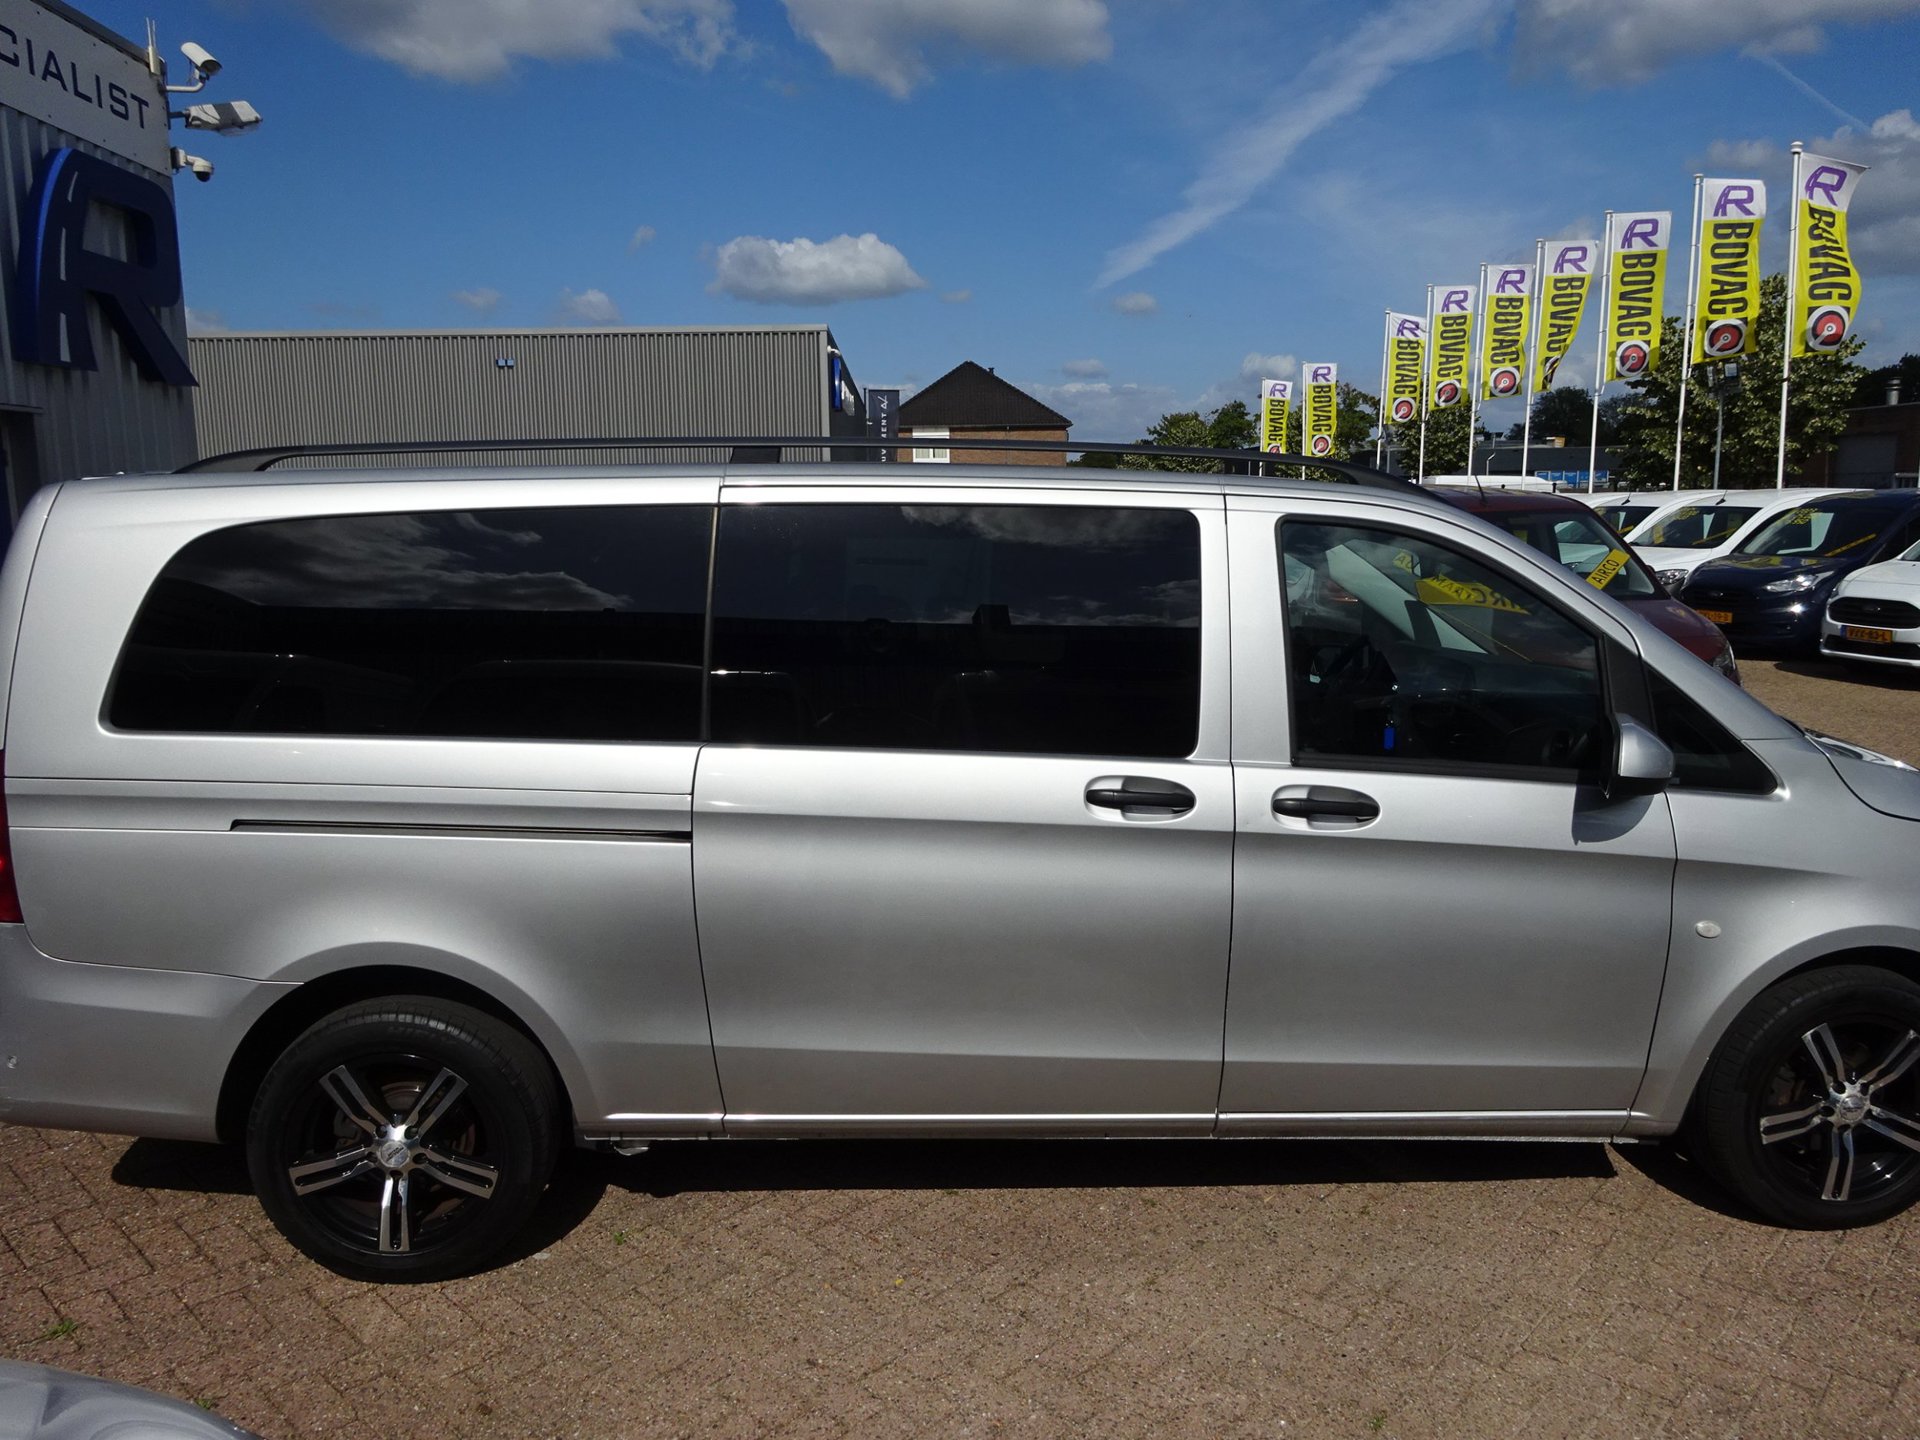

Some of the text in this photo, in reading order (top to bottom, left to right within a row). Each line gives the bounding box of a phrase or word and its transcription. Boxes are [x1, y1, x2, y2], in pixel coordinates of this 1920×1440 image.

[1616, 252, 1658, 337] BOVAG
[1707, 222, 1755, 315] BOVAG
[1437, 315, 1468, 378] BOVAG
[1490, 297, 1524, 364] BOVAG
[1393, 339, 1420, 395] BOVAG
[1268, 399, 1286, 442] BOVAG
[1312, 385, 1332, 432] BOVAG
[1591, 559, 1620, 585] AIRCO
